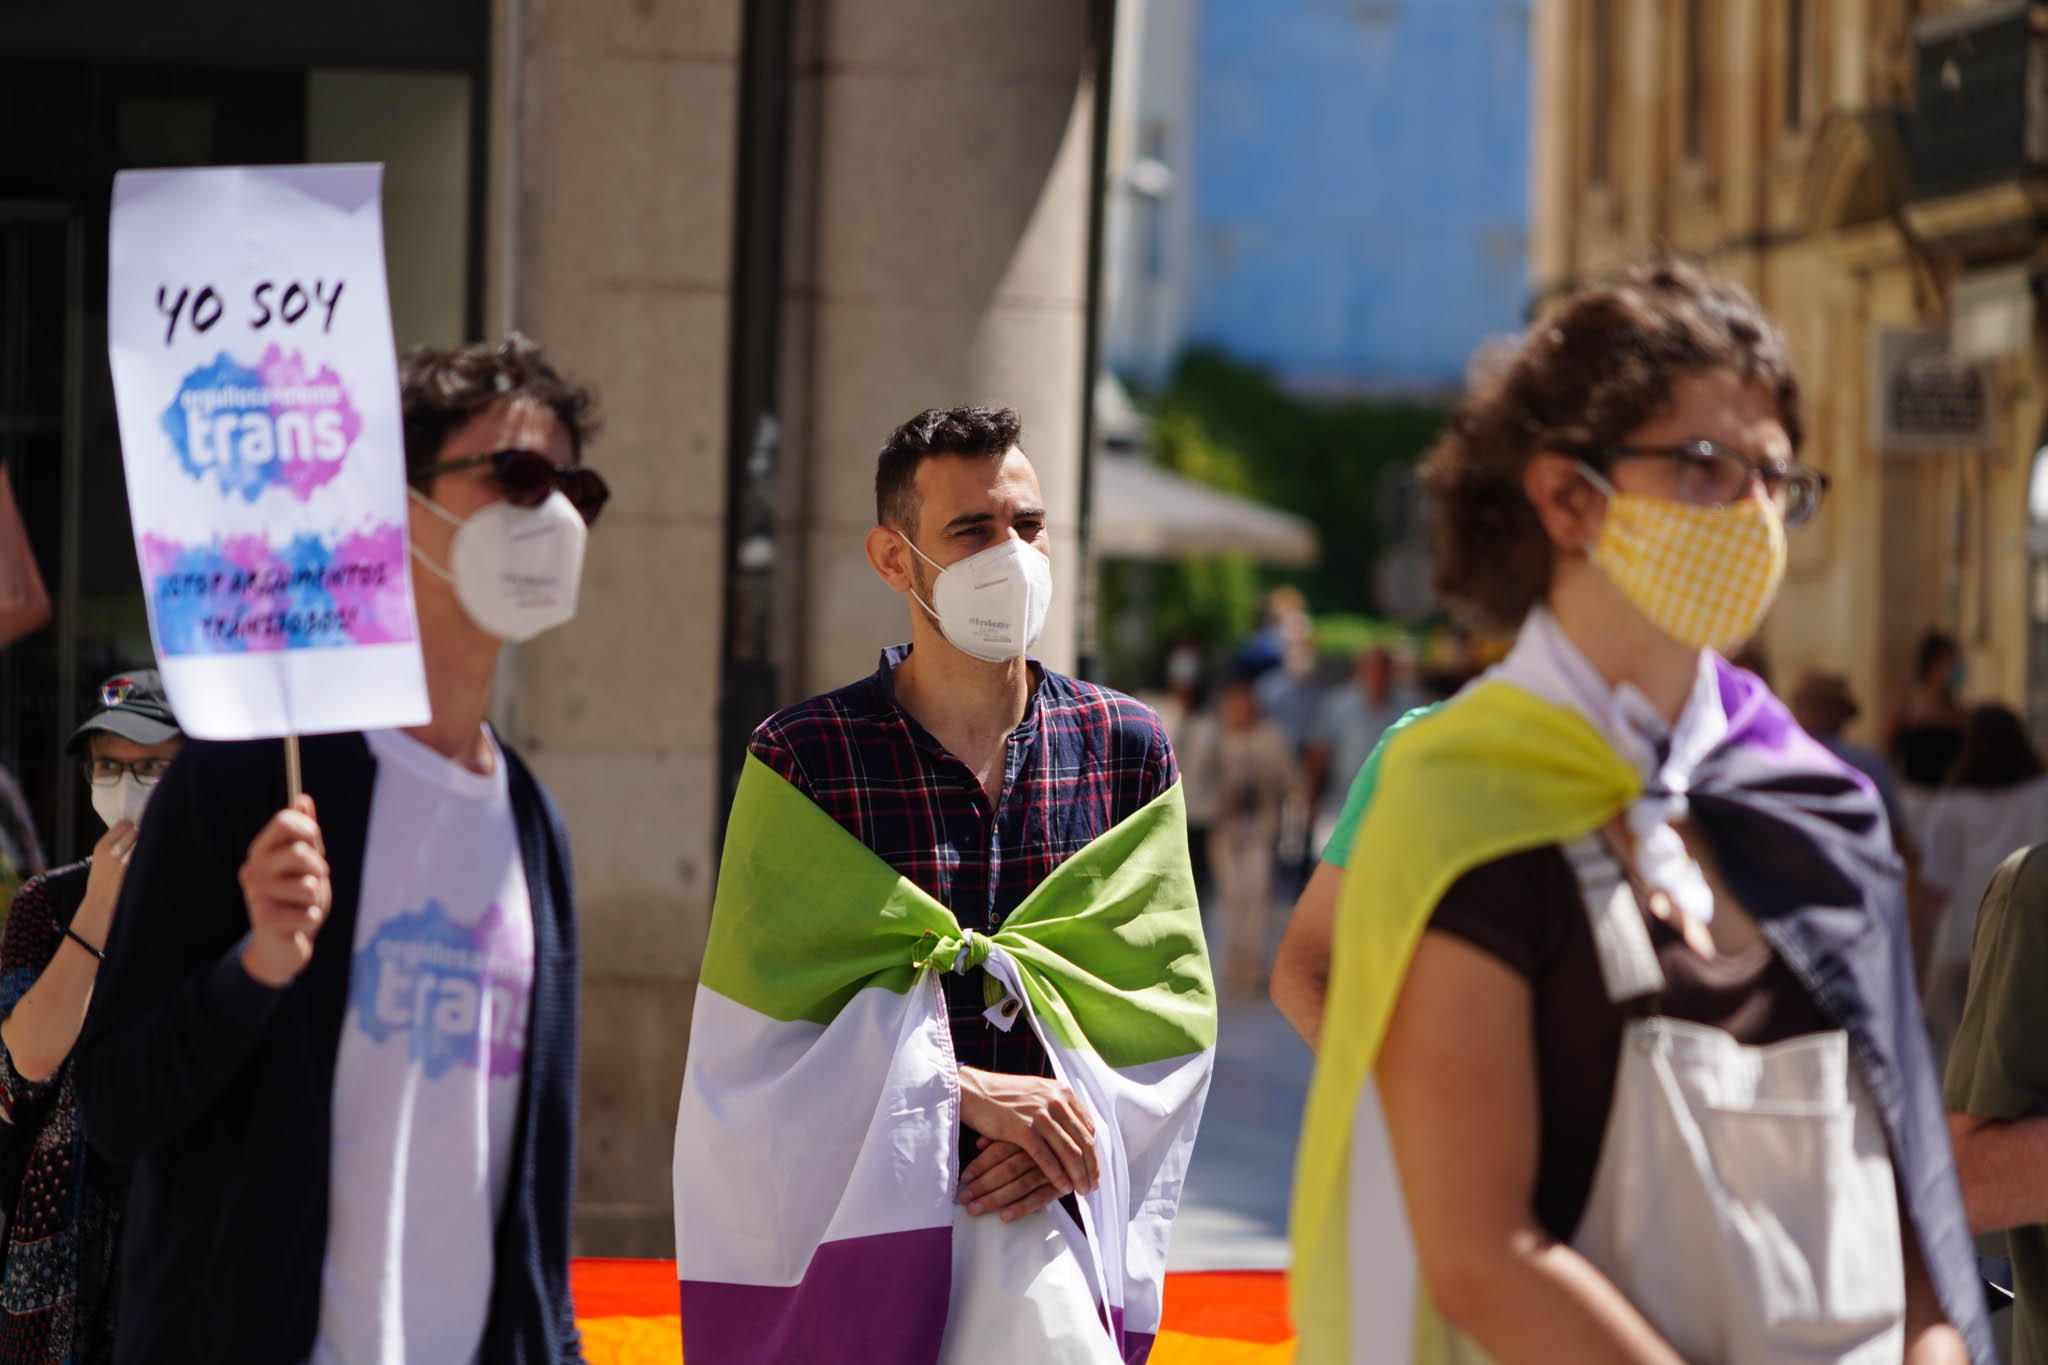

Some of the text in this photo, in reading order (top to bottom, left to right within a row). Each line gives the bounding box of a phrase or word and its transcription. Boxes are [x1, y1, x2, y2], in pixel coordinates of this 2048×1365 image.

[157, 277, 345, 348] YO SOY
[186, 409, 348, 467] trans
[228, 561, 388, 598] ARGUMENTOS
